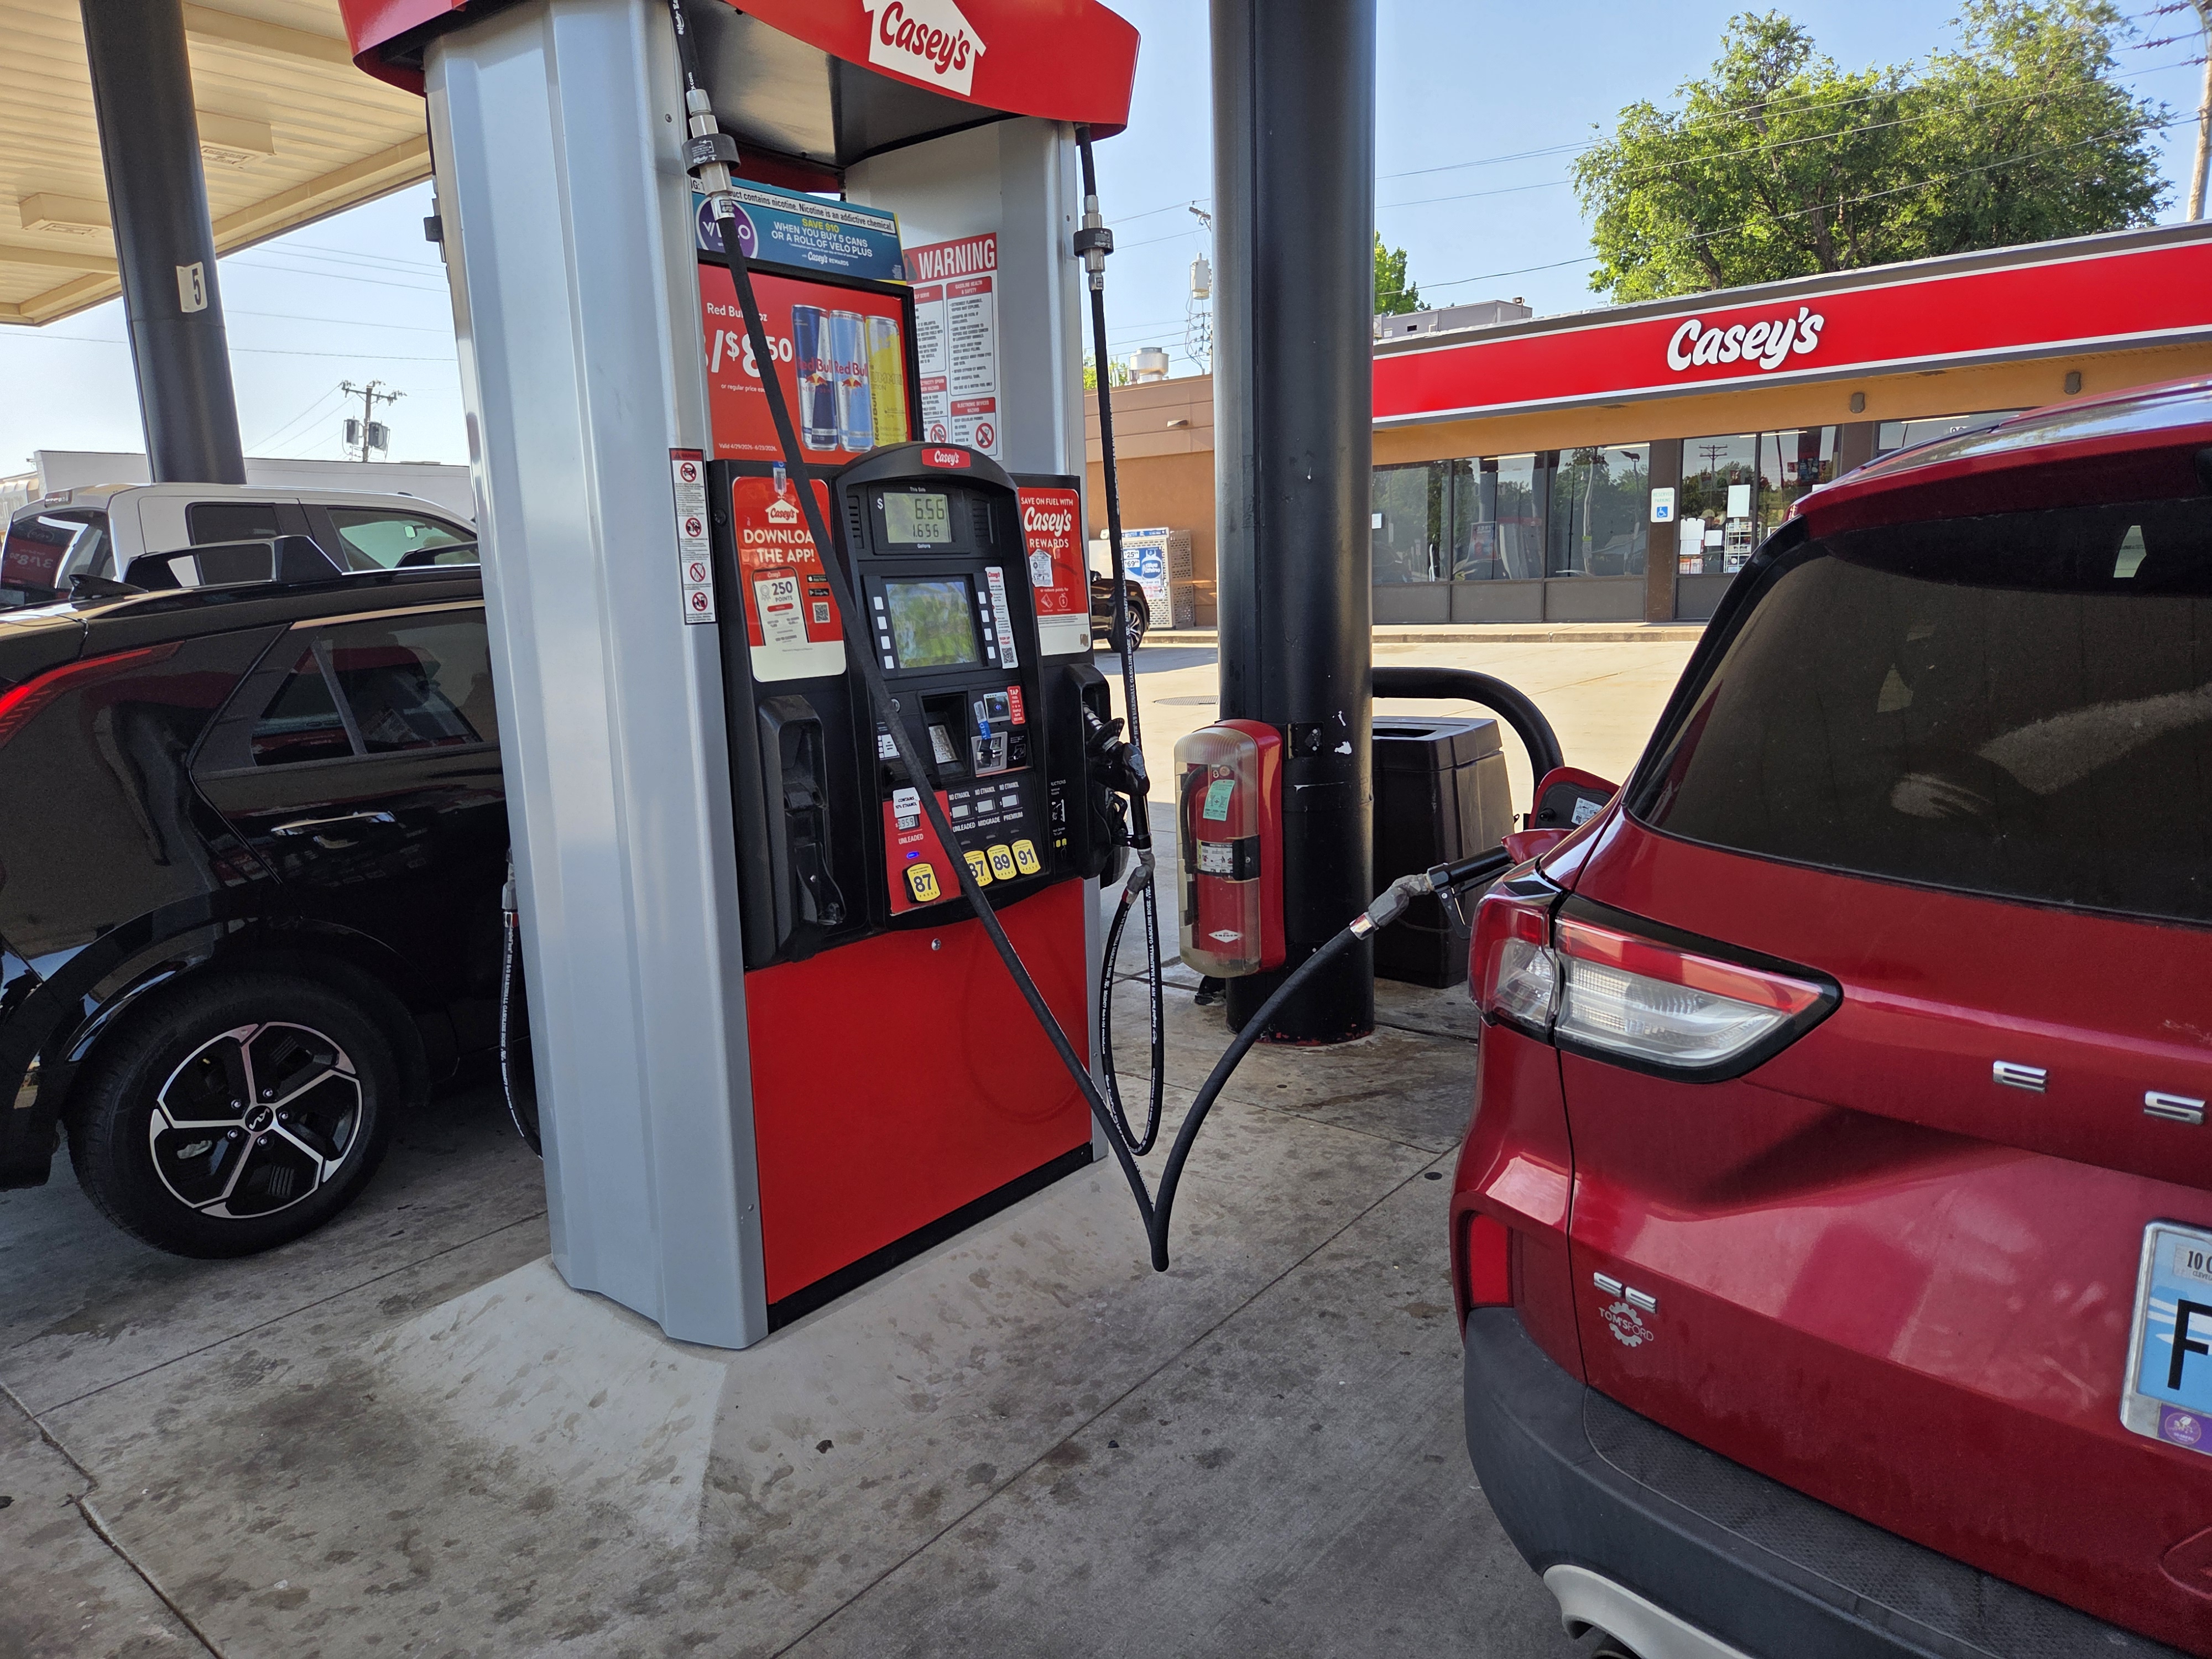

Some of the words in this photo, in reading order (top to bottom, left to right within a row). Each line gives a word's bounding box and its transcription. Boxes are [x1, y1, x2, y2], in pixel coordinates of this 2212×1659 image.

[880, 1, 971, 75] Casey's
[743, 194, 770, 205] contains
[772, 197, 798, 211] nicotine.
[799, 203, 824, 216] Nicotine
[825, 208, 831, 217] is
[840, 212, 866, 225] addictive
[867, 218, 894, 231] chemical.
[802, 218, 824, 230] SAVE
[826, 222, 839, 233] $10
[774, 221, 800, 234] WHEN
[801, 227, 819, 238] YOU
[821, 231, 837, 241] BUY
[839, 234, 844, 243] 5
[846, 236, 868, 248] CANS
[771, 231, 784, 241] OR
[786, 233, 792, 242] A
[794, 234, 816, 247] ROLL
[816, 239, 828, 248] OF
[829, 242, 851, 253] VELO
[852, 247, 873, 257] PLUS
[807, 251, 828, 264] Casey's
[918, 239, 995, 280] WARNING
[193, 268, 202, 306] 5
[706, 302, 726, 316] Red
[728, 305, 743, 319] Bul
[1667, 307, 1824, 371] Casey's
[797, 357, 815, 372] Red
[834, 361, 851, 375] Red
[934, 450, 959, 466] Casey's
[915, 499, 945, 520] 6.56
[1021, 497, 1035, 505] SAVE
[1036, 497, 1045, 505] ON
[1046, 498, 1059, 506] FUEL
[1060, 498, 1073, 507] WITH
[770, 508, 795, 520] Casey's
[1024, 507, 1072, 537] Casey's
[743, 529, 815, 544] DOWNLOA
[1029, 538, 1069, 549] REWARDS
[757, 549, 784, 563] THE
[787, 549, 815, 563] APP!
[771, 581, 792, 596] 250
[980, 786, 995, 795] ETHANOL
[978, 816, 1001, 826] MIDGRADE
[1003, 811, 1023, 821] PREMIUM
[952, 822, 975, 832] UNLEADED
[898, 833, 924, 844] UNLEADED
[993, 853, 1011, 871] 89
[1018, 848, 1036, 865] 91
[968, 860, 984, 878] 87
[914, 873, 932, 893] 87
[2187, 1250, 2203, 1270] 10
